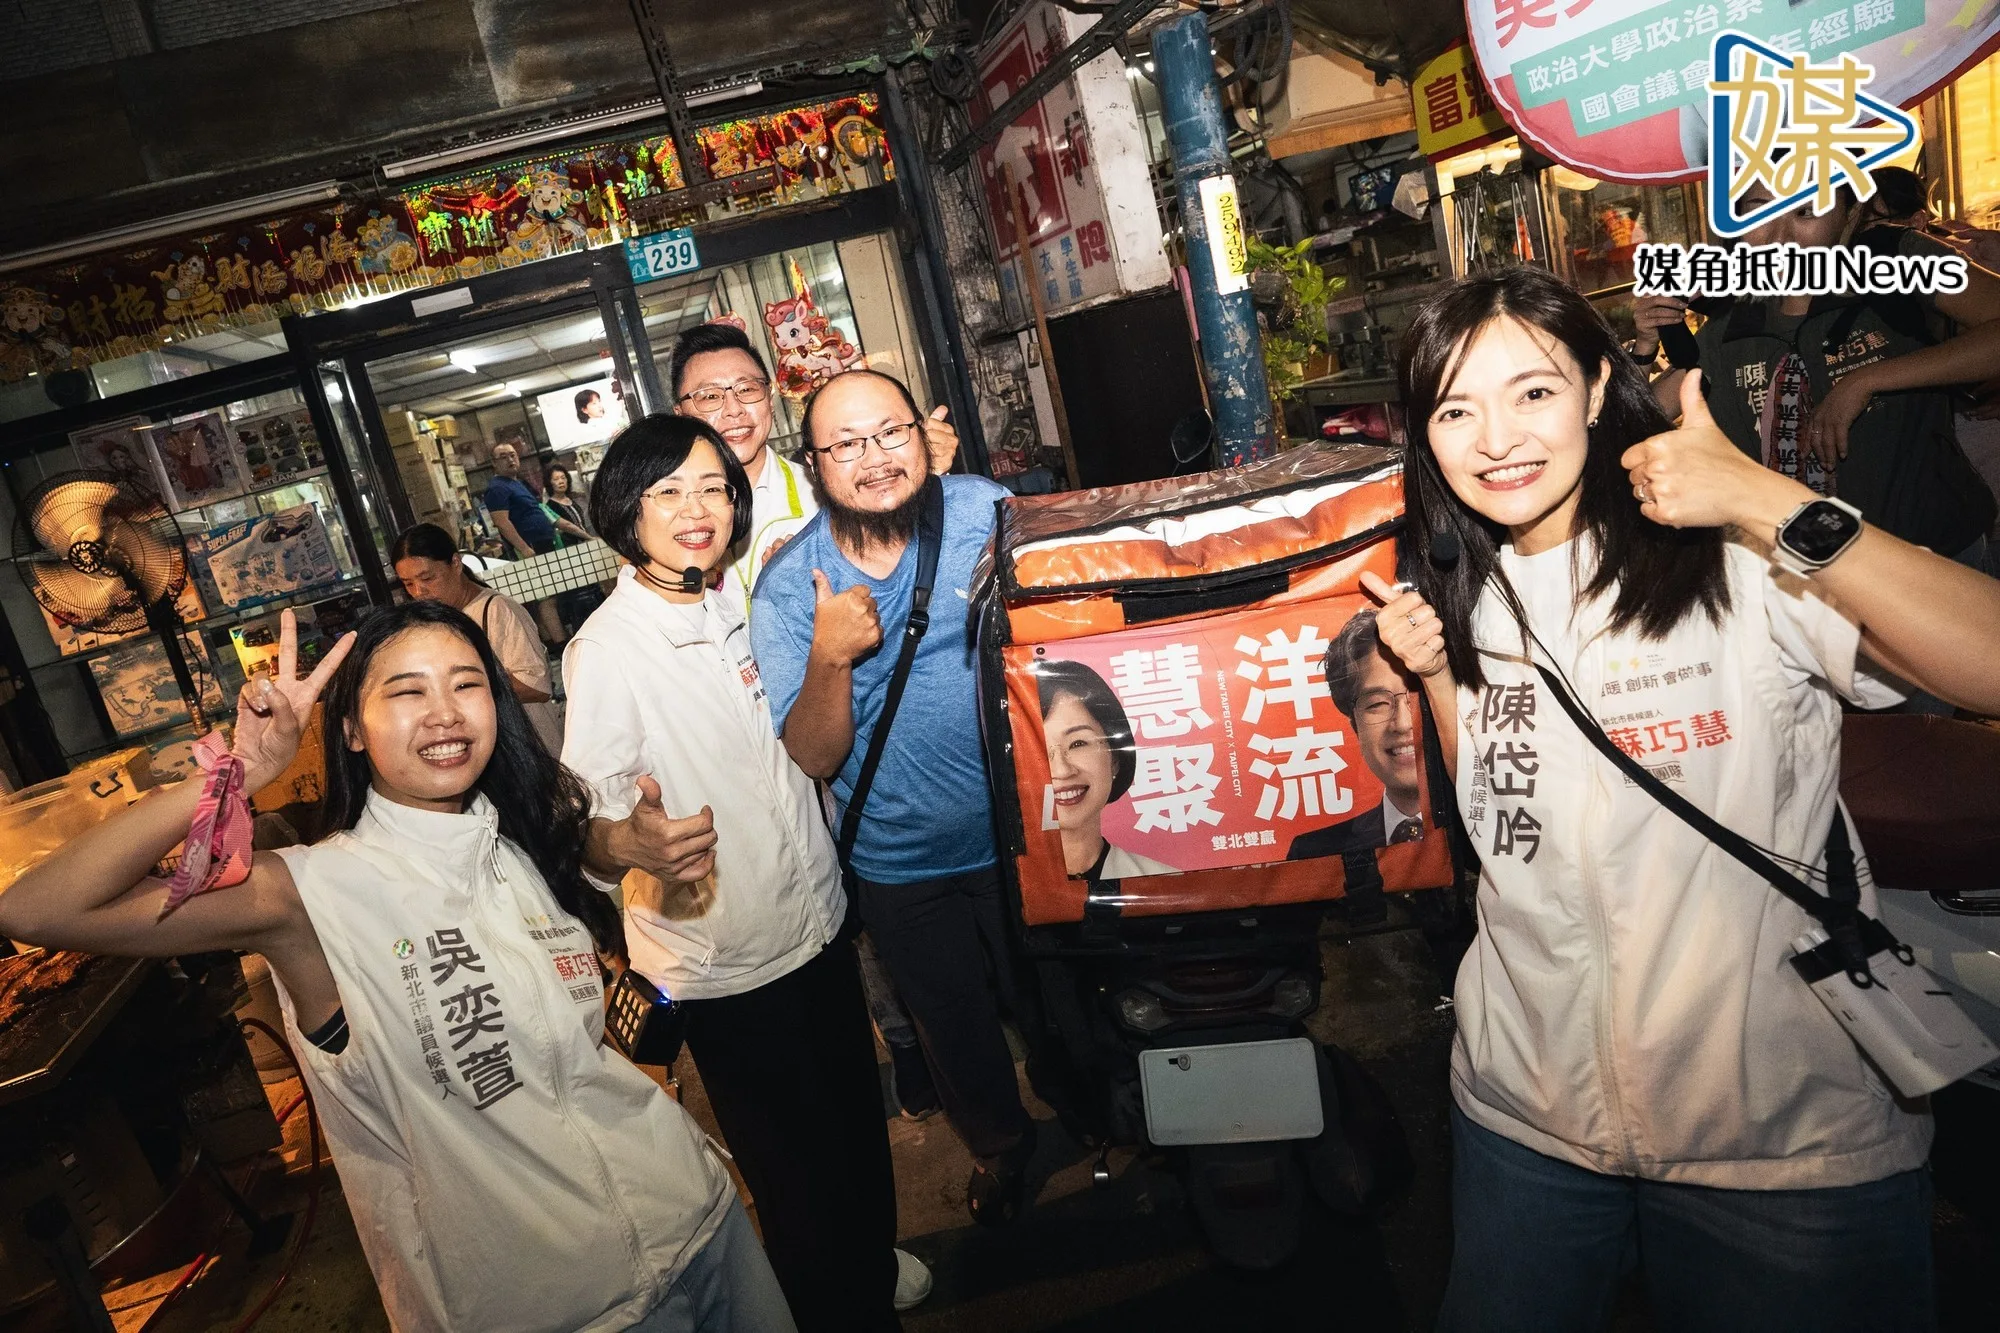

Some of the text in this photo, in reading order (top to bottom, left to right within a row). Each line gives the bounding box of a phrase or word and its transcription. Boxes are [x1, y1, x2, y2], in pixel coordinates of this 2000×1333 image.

[1527, 0, 1763, 94] 政治大學政治系
[1219, 195, 1244, 273] 259492
[651, 241, 692, 273] 239
[1743, 362, 1768, 438] 陳佳
[207, 533, 228, 551] SUPER
[1217, 670, 1227, 691] NEW
[1220, 692, 1231, 719] TAIPEI
[1233, 625, 1353, 820] 洋流
[1601, 708, 1664, 726] 新北市長候選人
[1110, 642, 1226, 833] 慧聚
[1224, 720, 1234, 739] CITY
[1606, 709, 1733, 759] 蘇巧慧
[1229, 751, 1240, 780] TAIPEI
[1481, 681, 1542, 865] 陳岱吟
[1232, 780, 1242, 797] CITY
[1211, 829, 1276, 851] 雙北雙贏
[400, 962, 458, 1101] 新北市議員候選人
[425, 927, 523, 1111] 吳奕萱
